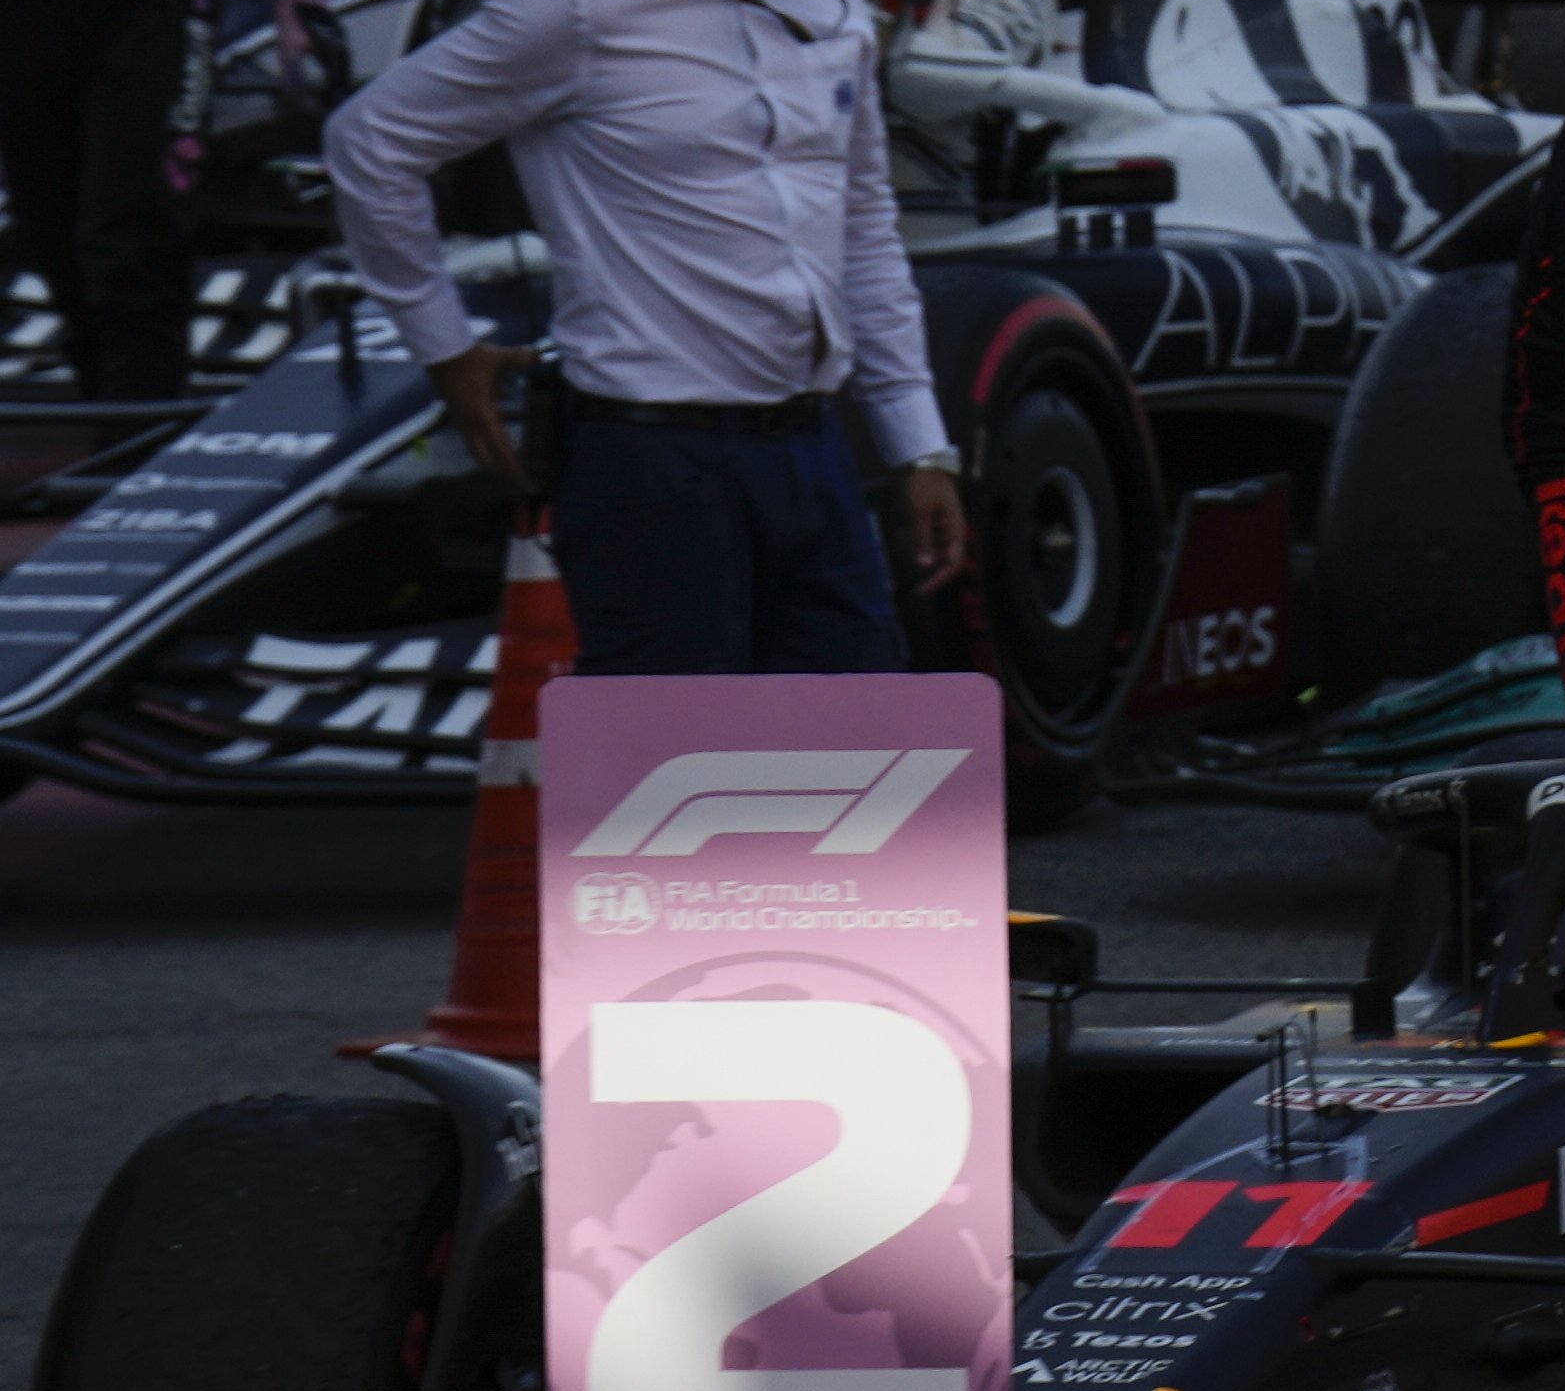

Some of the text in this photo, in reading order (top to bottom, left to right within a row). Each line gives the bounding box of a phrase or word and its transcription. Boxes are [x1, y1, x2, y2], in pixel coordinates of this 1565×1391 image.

[1161, 609, 1276, 679] INEOS
[719, 880, 842, 904] Formula
[667, 906, 965, 935] World Championship
[1105, 1180, 1376, 1249] 11
[1072, 1272, 1253, 1294] Cash App
[1043, 1294, 1231, 1322] citrix
[1069, 1328, 1198, 1349] Tezos
